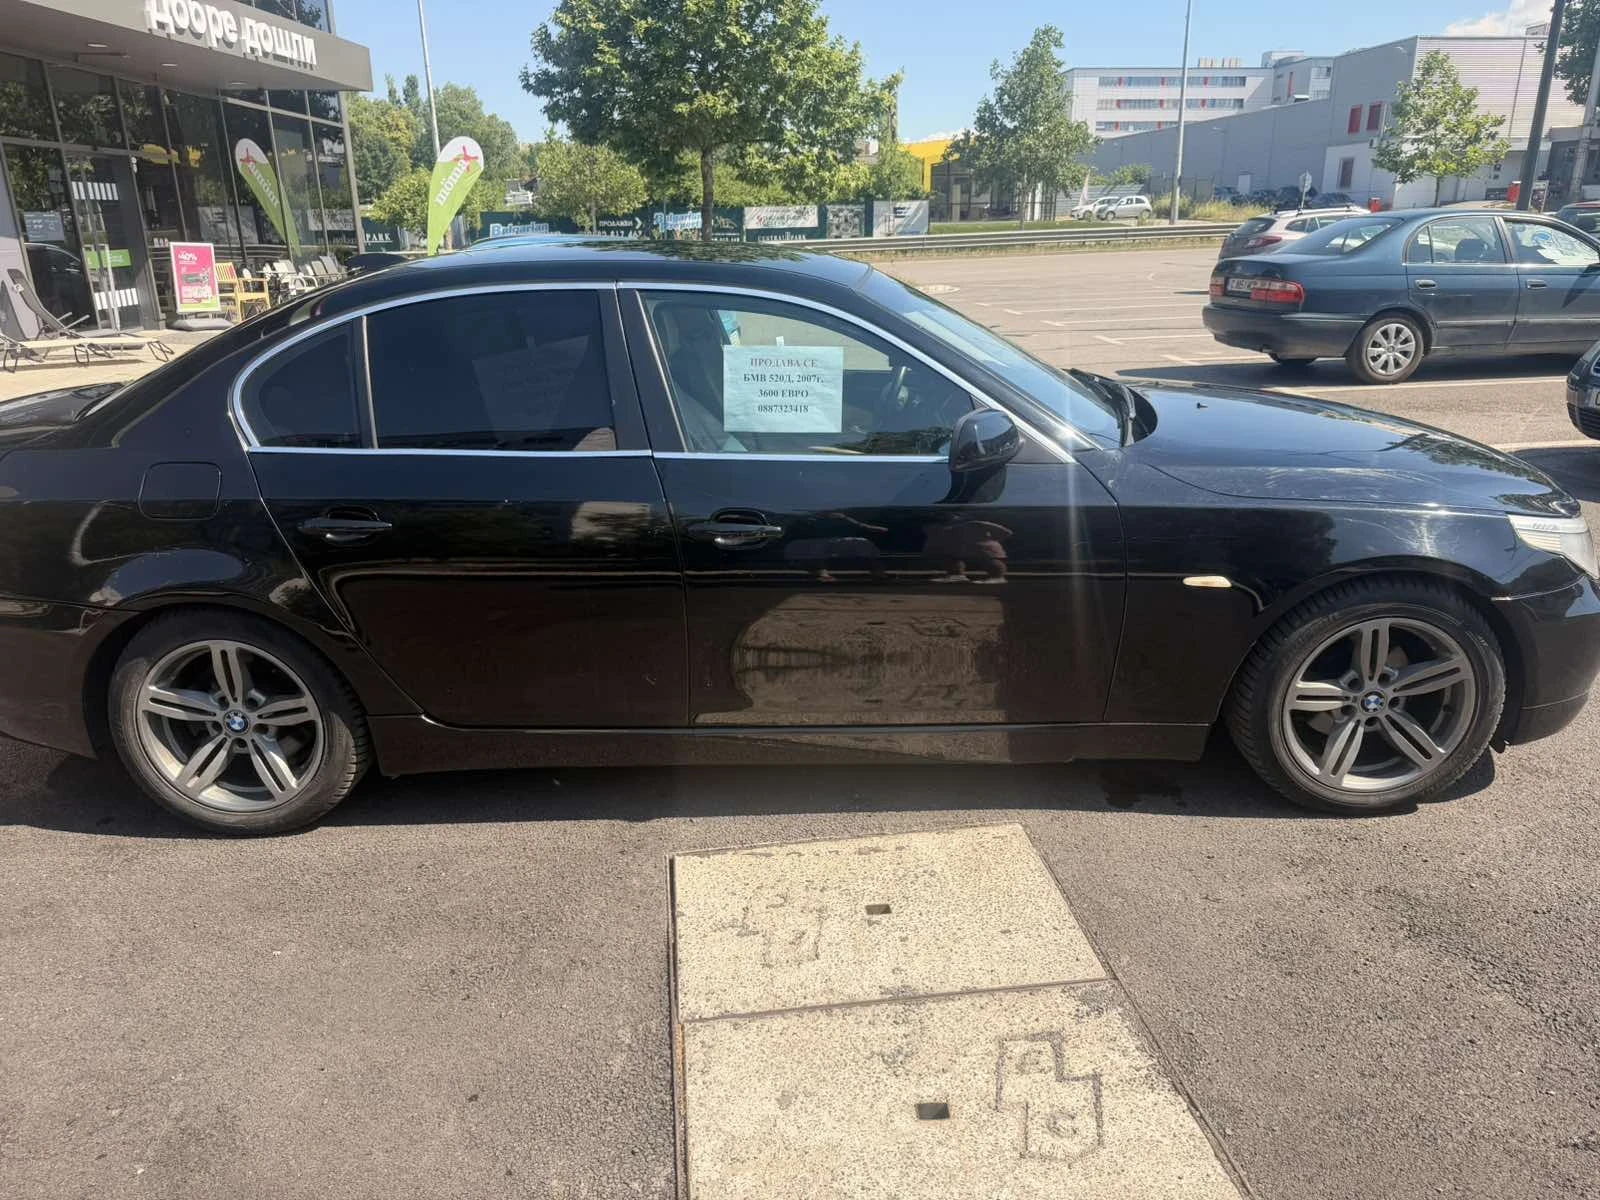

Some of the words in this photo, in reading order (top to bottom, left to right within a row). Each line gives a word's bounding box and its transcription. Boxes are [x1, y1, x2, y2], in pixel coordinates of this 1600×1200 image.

[239, 17, 317, 65] дошли
[750, 358, 800, 368] ПРОДАВА
[803, 359, 818, 368] СЕ
[743, 373, 767, 383] БМВ
[758, 389, 779, 398] 3600
[781, 389, 809, 398] ЕВРО
[757, 404, 809, 414] 0887323418
